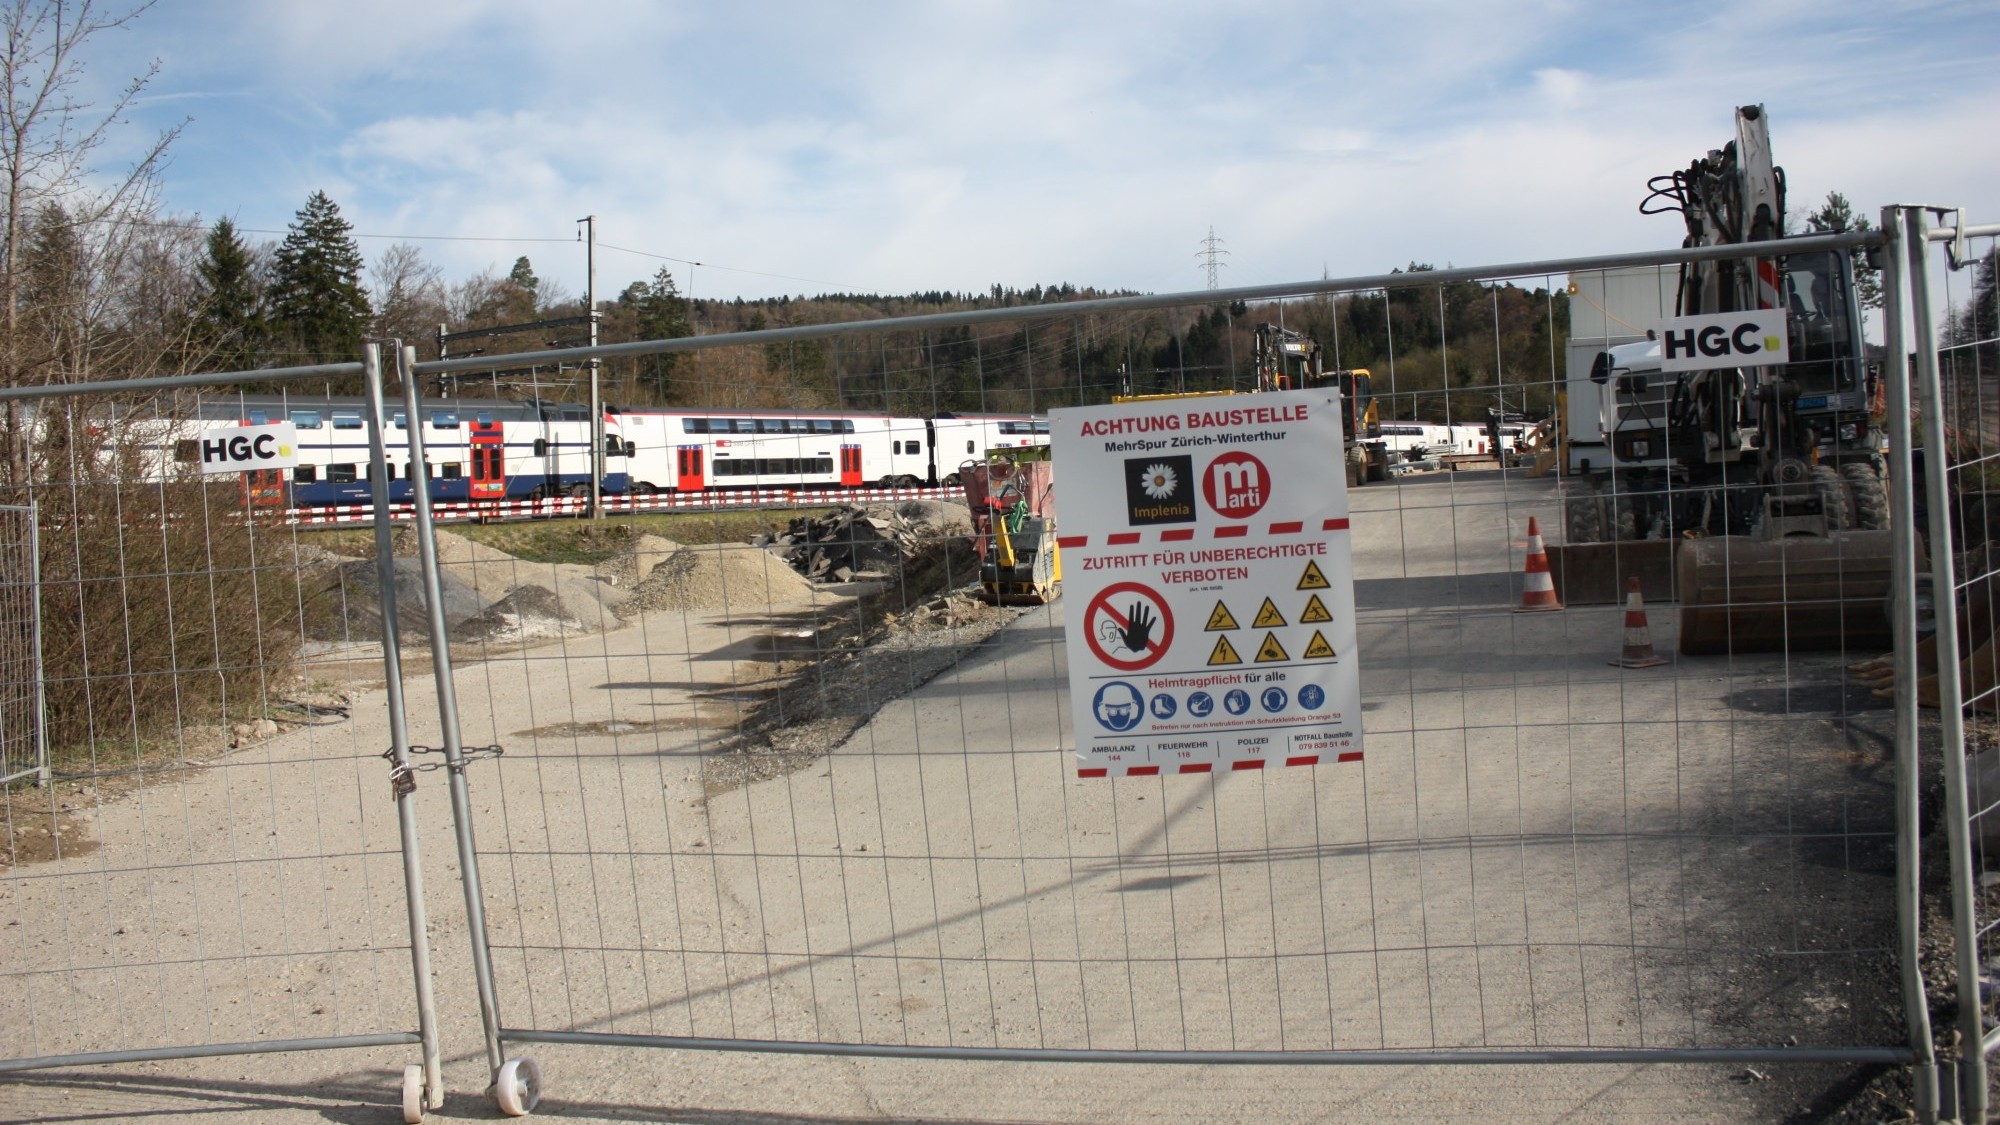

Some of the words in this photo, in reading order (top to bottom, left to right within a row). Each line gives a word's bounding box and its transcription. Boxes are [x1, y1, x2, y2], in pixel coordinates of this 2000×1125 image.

[1665, 323, 1761, 359] HGC
[1080, 413, 1180, 437] ACHTUNG
[1187, 404, 1309, 429] BAUSTELLE
[203, 434, 276, 463] HGC
[1105, 438, 1167, 453] MehrSpur
[1171, 430, 1287, 448] Zürich-Winterthur
[1134, 503, 1190, 520] Implenia
[1082, 554, 1148, 571] ZUTRITT
[1153, 548, 1185, 566] FÜR
[1190, 542, 1327, 564] UNBERECHTIGTE
[1161, 567, 1249, 584] VERBOTEN
[1148, 674, 1241, 689] Helmtragpflicht
[1245, 672, 1262, 684] für
[1265, 672, 1286, 683] alle
[1323, 731, 1353, 739] Baustelle
[1091, 745, 1135, 753] AMBULANZ
[1157, 741, 1208, 750] FEUERWEHR
